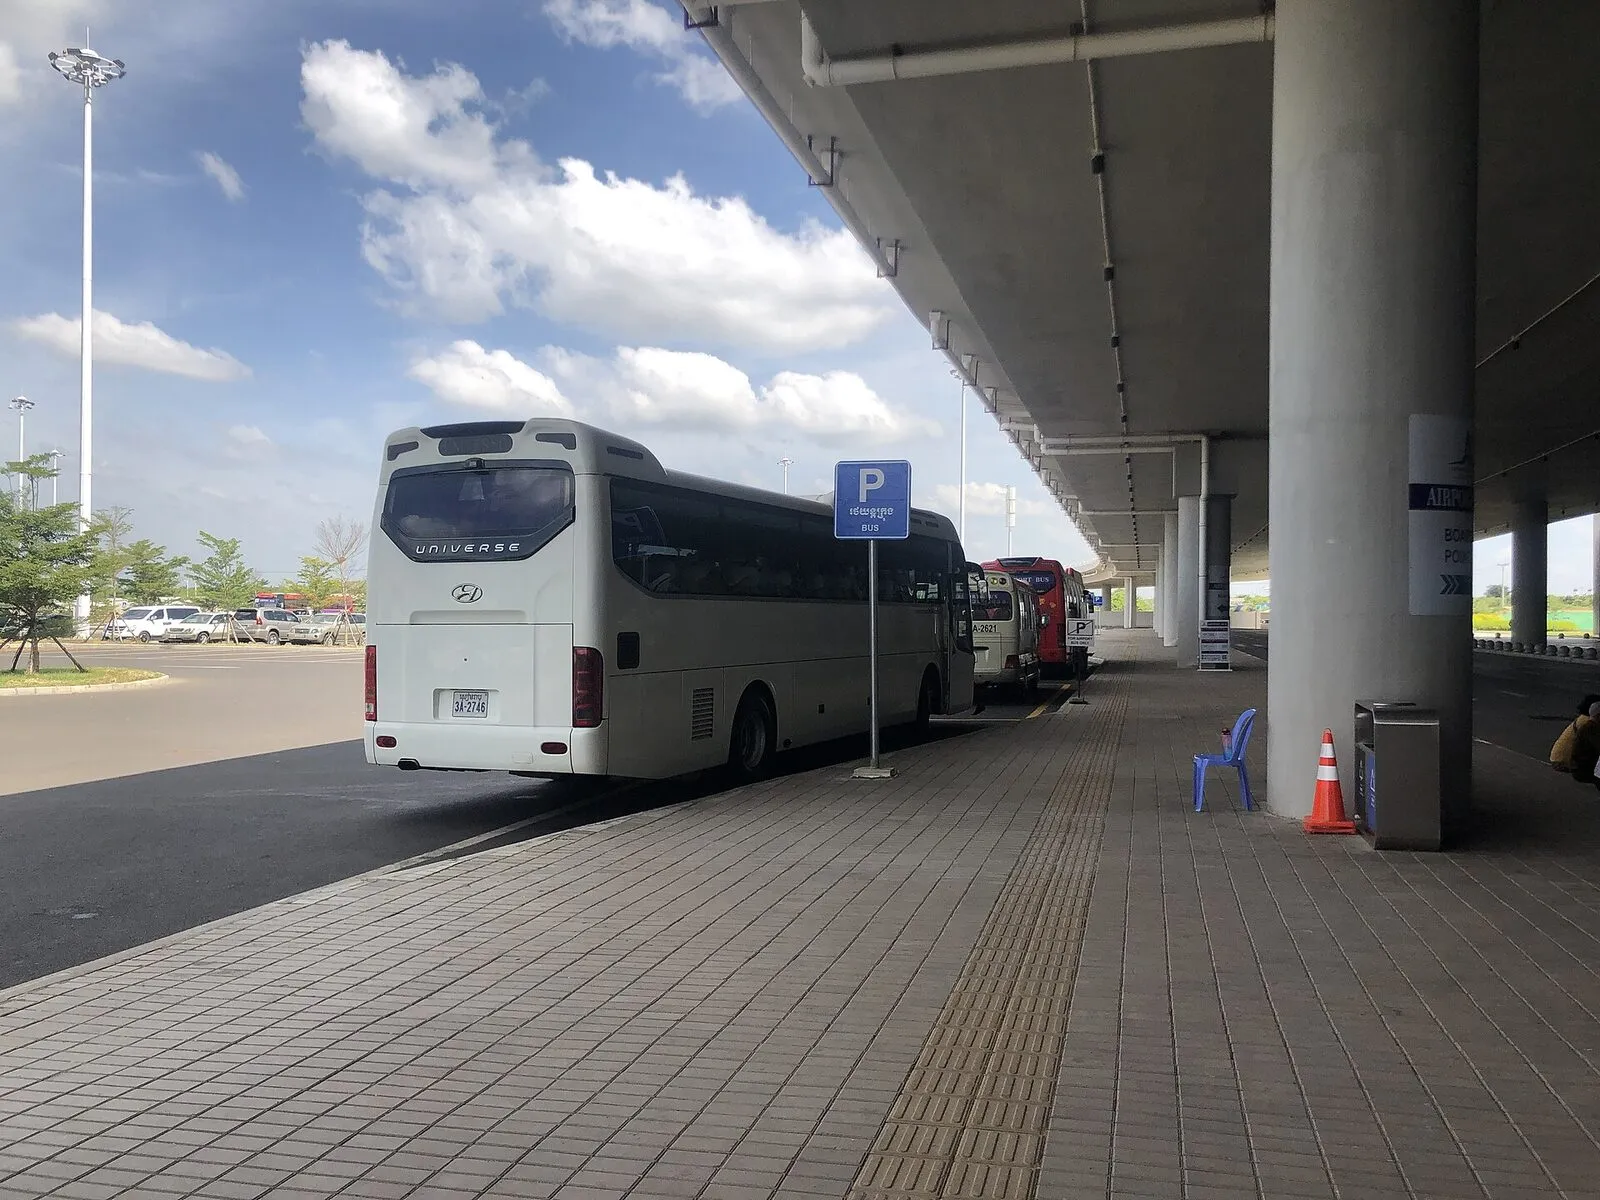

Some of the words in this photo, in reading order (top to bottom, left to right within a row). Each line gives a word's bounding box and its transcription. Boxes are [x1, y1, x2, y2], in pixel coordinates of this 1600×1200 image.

[859, 468, 885, 503] P
[861, 524, 879, 532] BUS
[416, 543, 520, 554] UNIVERSE
[454, 701, 486, 713] 3A-2746
